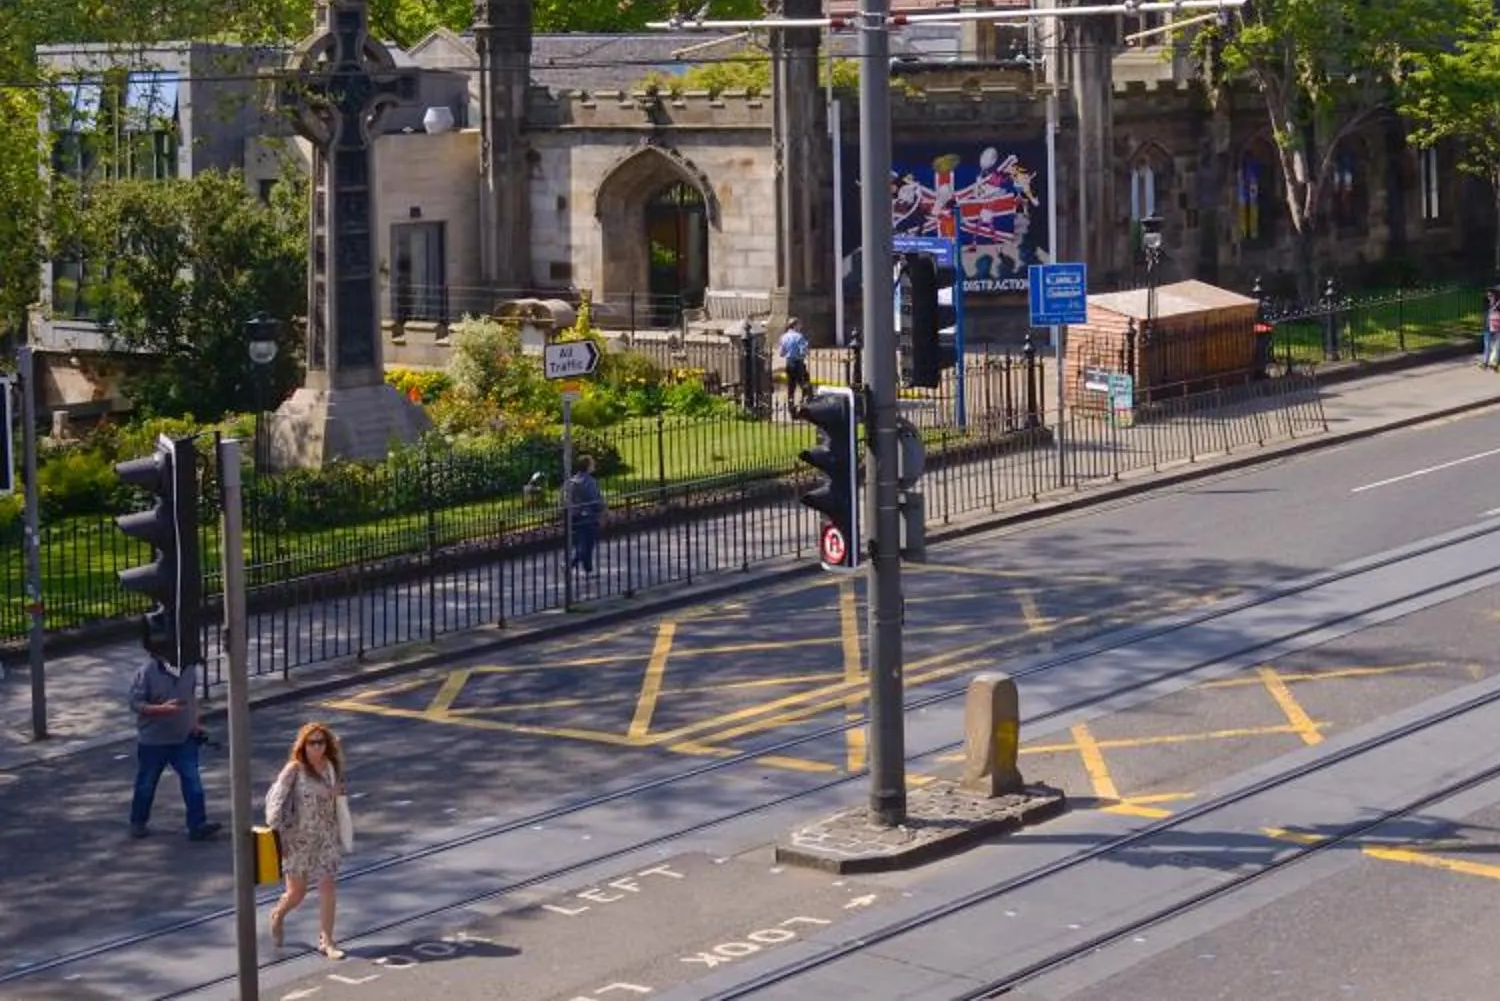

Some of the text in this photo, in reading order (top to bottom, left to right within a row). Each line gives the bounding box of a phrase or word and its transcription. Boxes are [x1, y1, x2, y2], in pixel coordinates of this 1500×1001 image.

[549, 359, 583, 373] Traffic
[560, 347, 573, 358] All
[541, 864, 685, 915] LEFT
[326, 931, 494, 985] LOOK
[679, 915, 833, 967] LOOK
